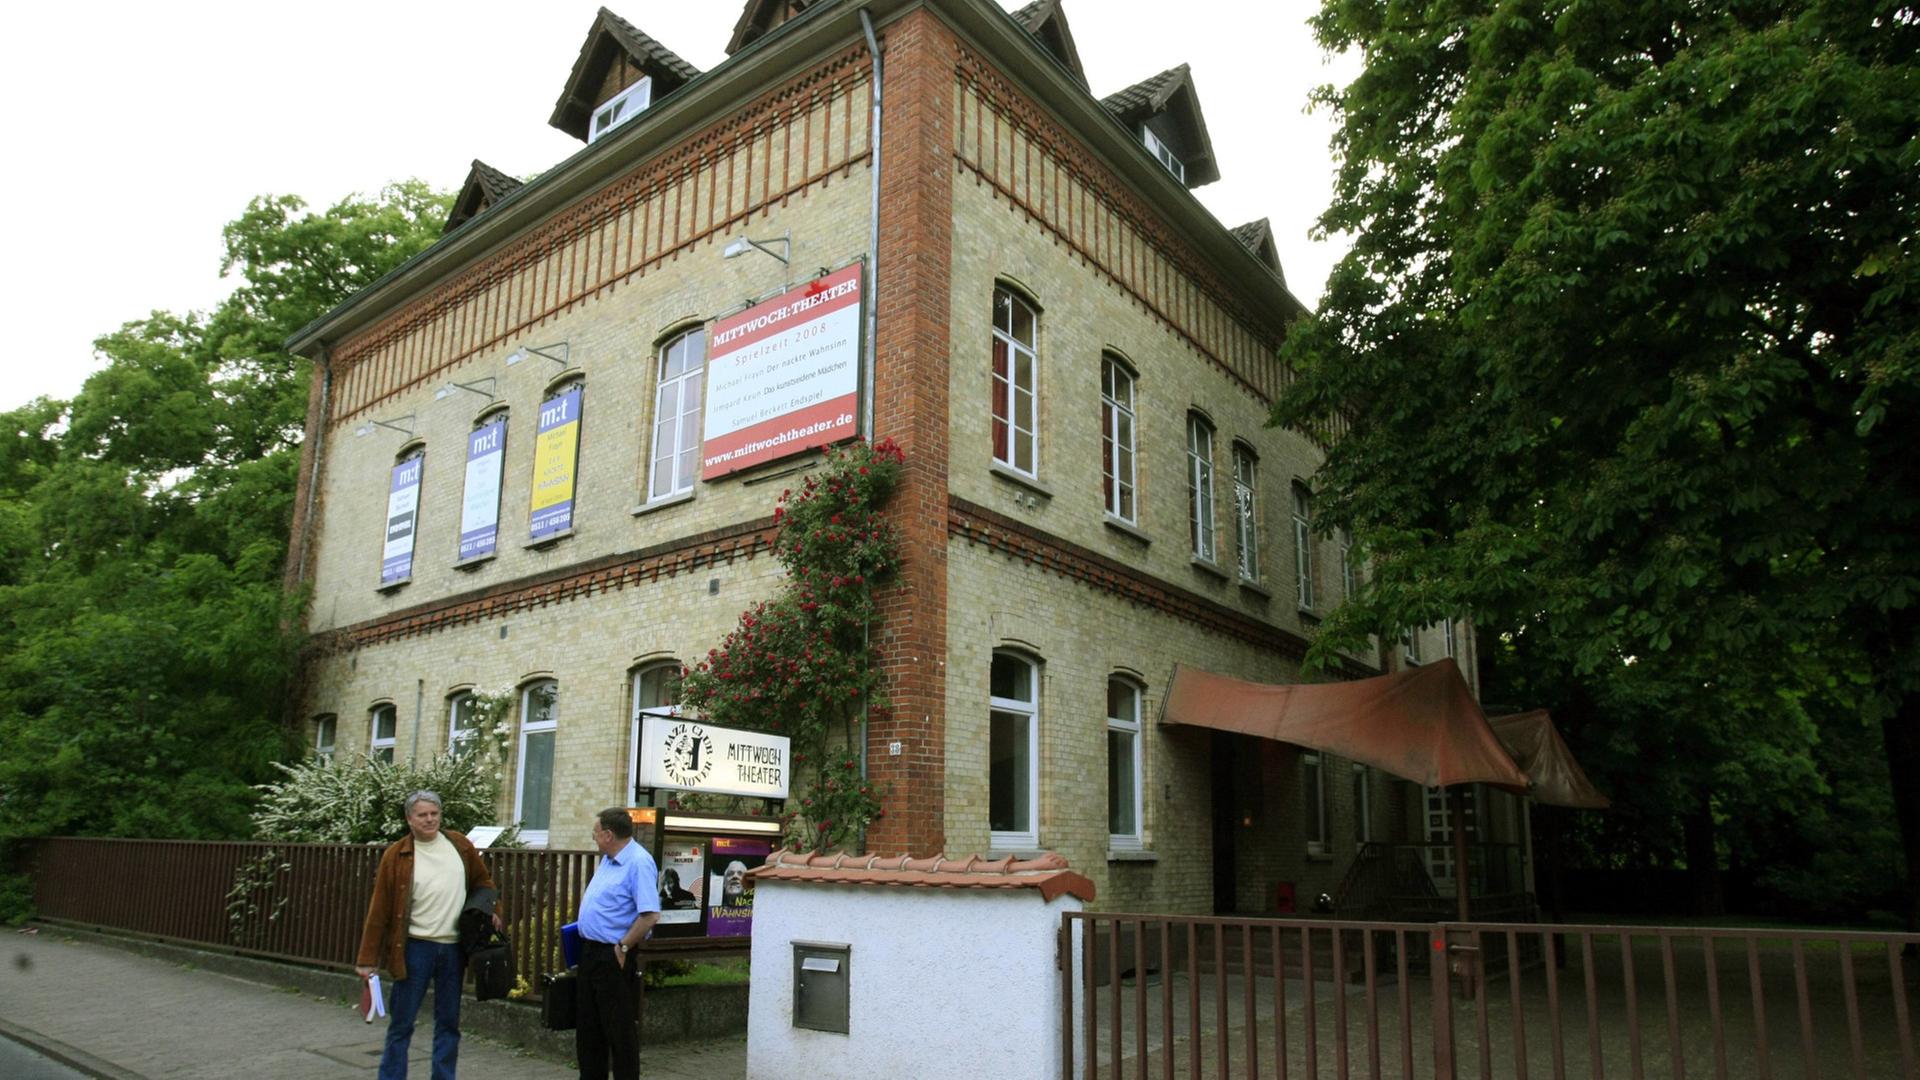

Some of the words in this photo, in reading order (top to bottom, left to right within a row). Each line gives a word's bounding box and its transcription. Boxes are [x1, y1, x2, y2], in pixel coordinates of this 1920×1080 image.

[713, 279, 857, 347] MITTWOCH:THEATER
[735, 338, 788, 366] Spielzeit
[795, 323, 827, 343] 2008
[716, 376, 742, 392] Michael
[766, 363, 780, 374] Der
[781, 353, 806, 367] nackte
[809, 339, 847, 357] Wahnsinn
[763, 385, 776, 395] Das
[817, 360, 848, 376] Mädchen
[541, 399, 568, 429] m:t
[732, 411, 758, 427] Samuel
[760, 401, 788, 417] Beckett
[790, 389, 824, 407] Endspiel
[475, 428, 498, 454] m:t
[704, 413, 853, 467] www.mittwochtheater.de
[400, 463, 419, 486] m:t
[664, 723, 688, 751] JAZZ
[691, 725, 714, 755] CLUB
[727, 743, 782, 766] MITTWOCH
[663, 758, 713, 787] HANNOVER
[738, 765, 782, 788] THEATER
[735, 896, 753, 906] NAC
